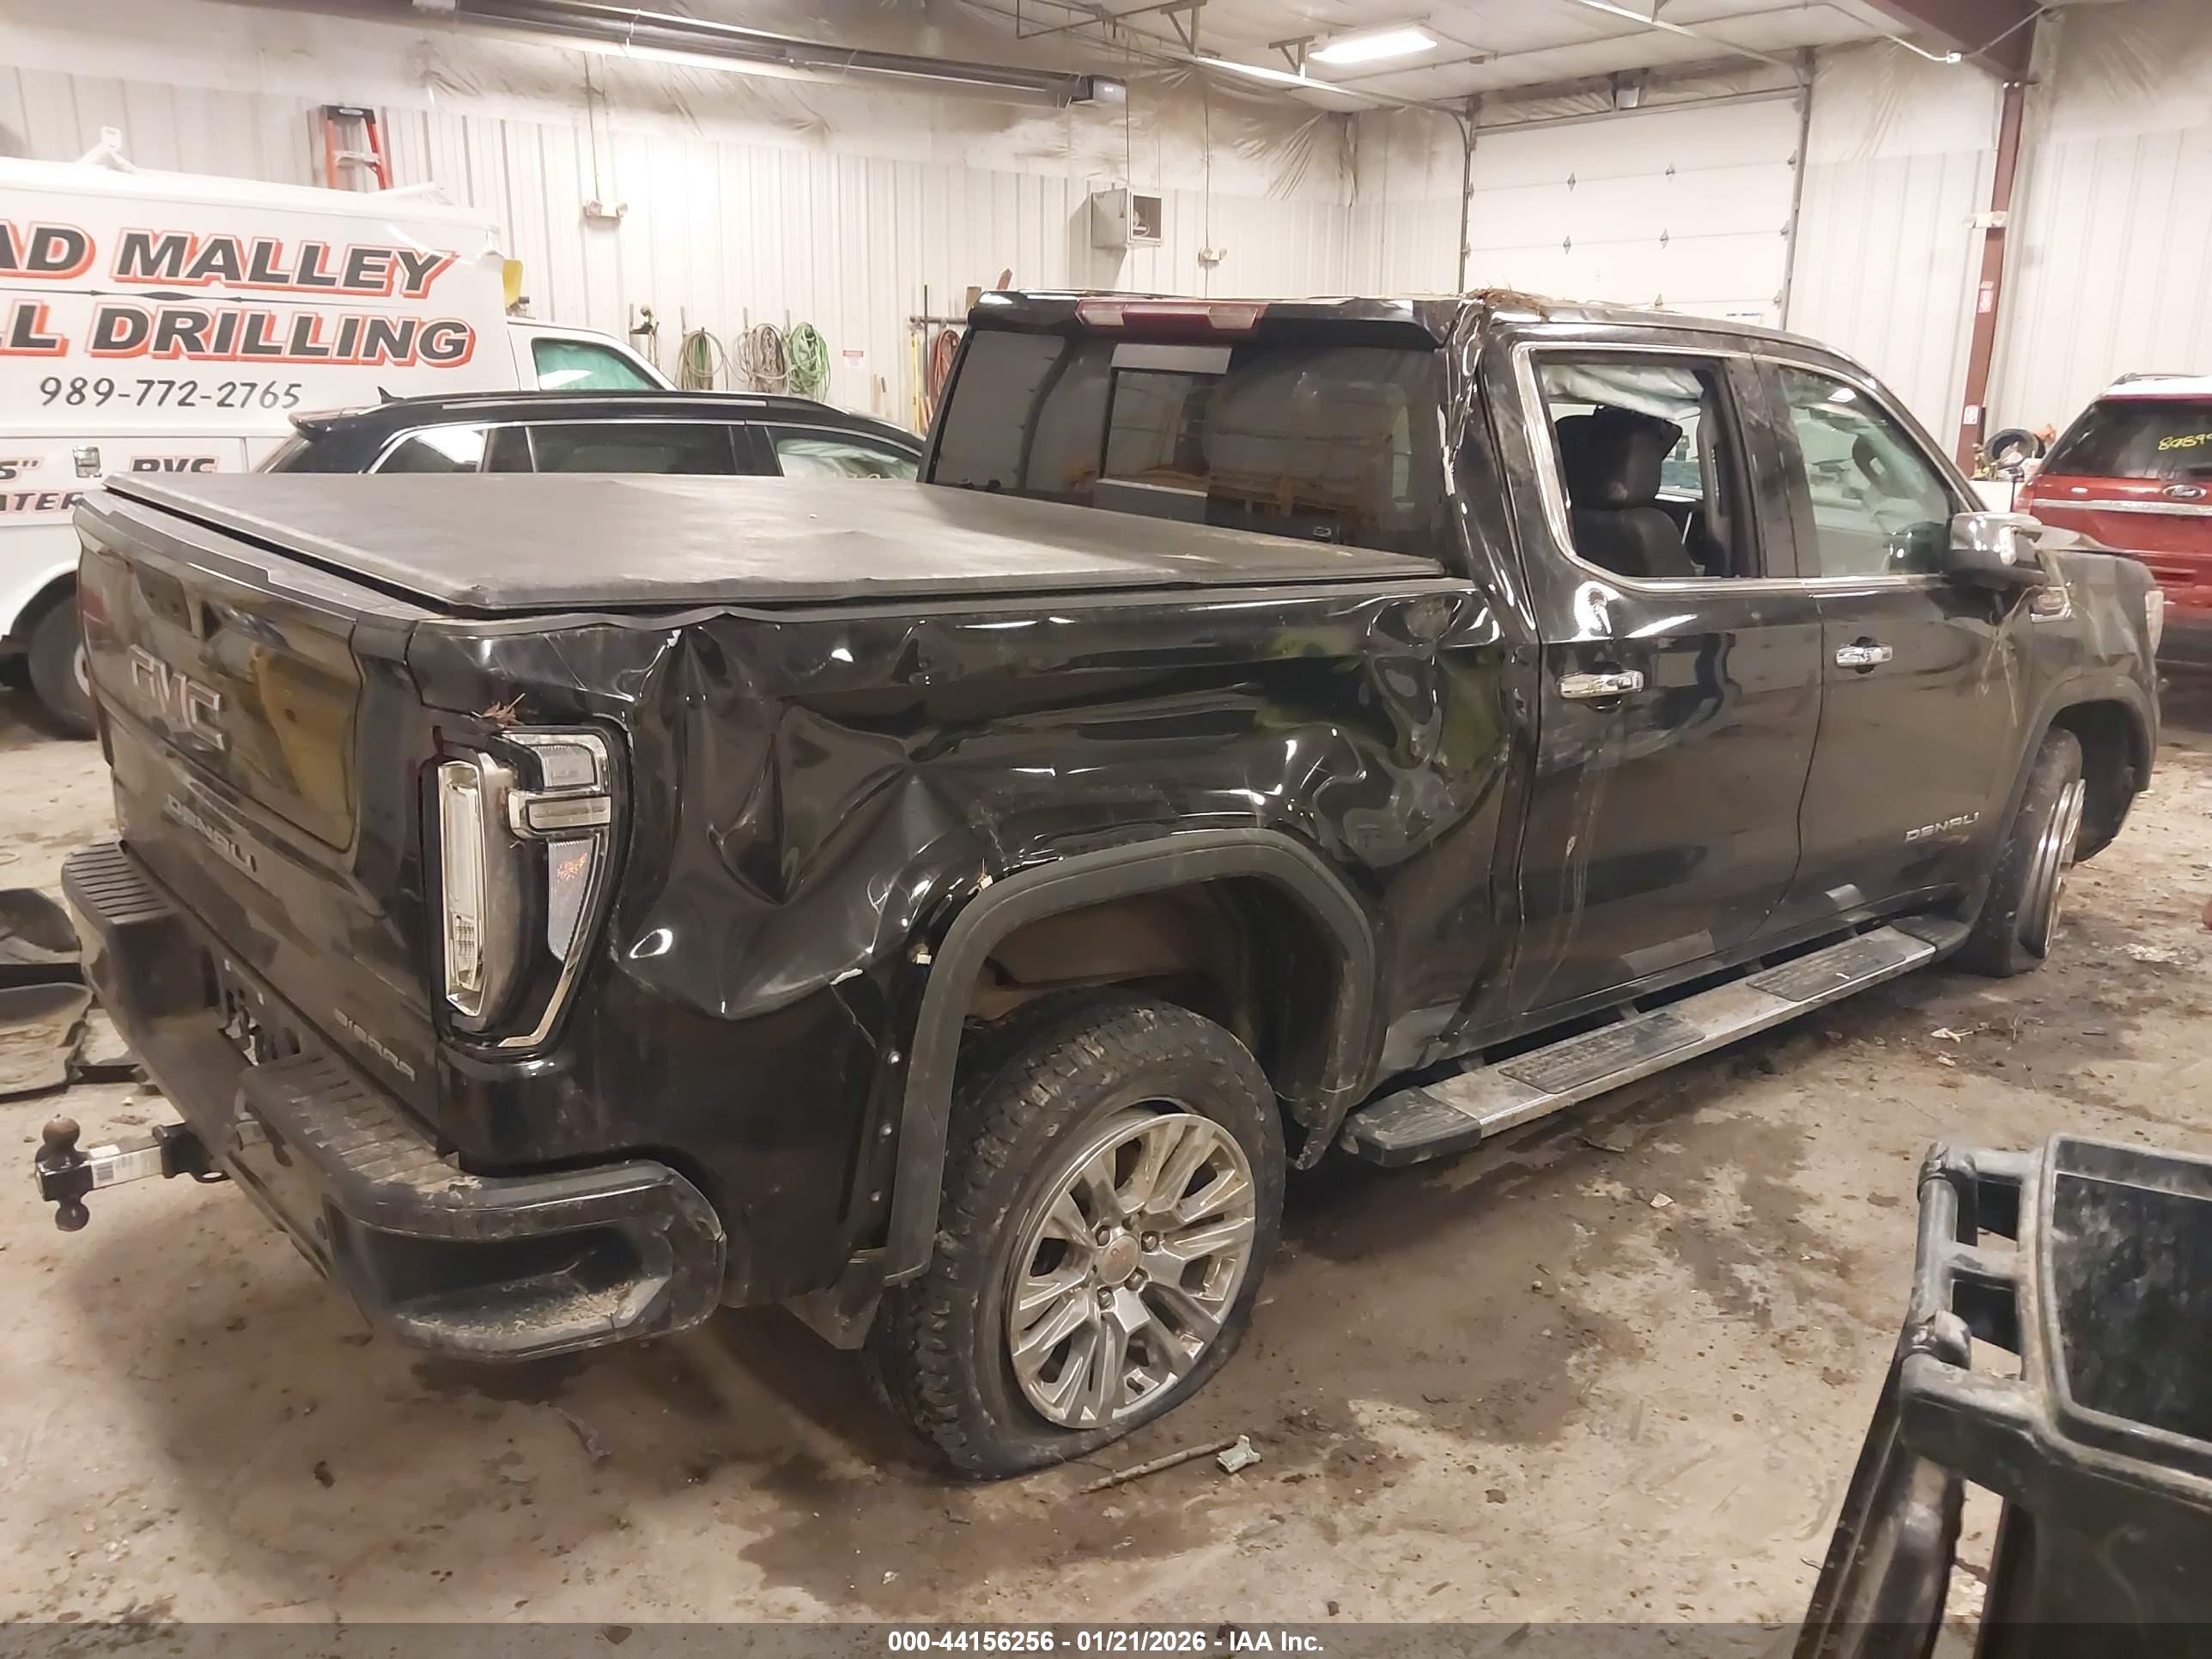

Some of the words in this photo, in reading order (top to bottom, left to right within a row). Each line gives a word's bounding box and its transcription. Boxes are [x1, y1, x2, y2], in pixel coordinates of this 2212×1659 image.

[113, 228, 455, 297] MALLEY
[88, 303, 474, 366] DRILLING
[40, 376, 302, 409] 989-772-2765
[1905, 811, 1979, 842] DENALI
